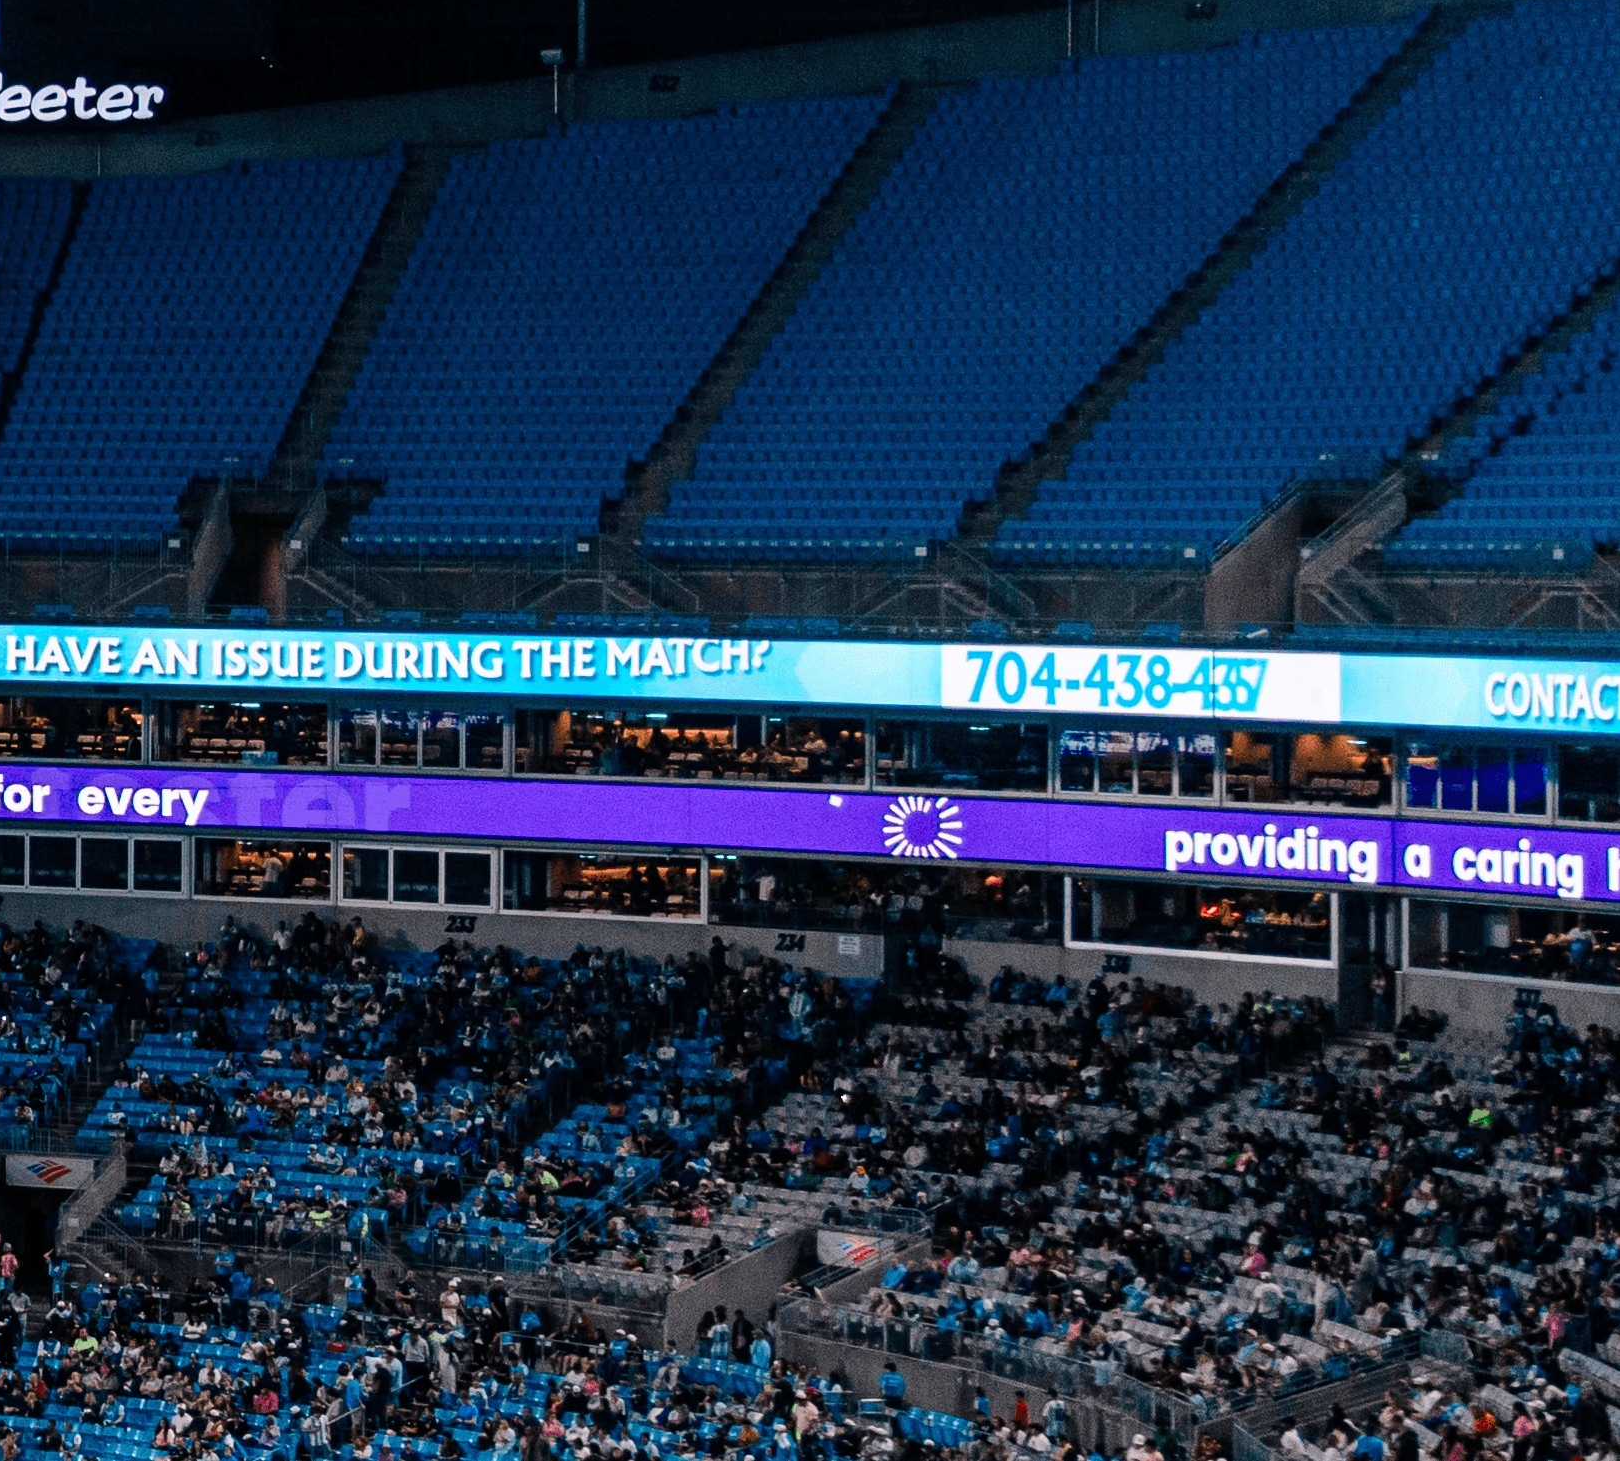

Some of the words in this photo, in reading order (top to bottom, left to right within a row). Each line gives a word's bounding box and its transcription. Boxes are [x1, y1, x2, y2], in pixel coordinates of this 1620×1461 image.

[6, 635, 121, 672] HAVE
[129, 636, 199, 674] AN
[208, 638, 323, 677] ISSUE
[334, 641, 502, 678] DURING
[512, 640, 595, 677] THE
[1484, 671, 1620, 720] CONTAC
[78, 786, 209, 825] every
[1166, 824, 1378, 884] providing
[1405, 844, 1431, 878] a
[1454, 838, 1584, 898] caring
[773, 933, 806, 952] 234
